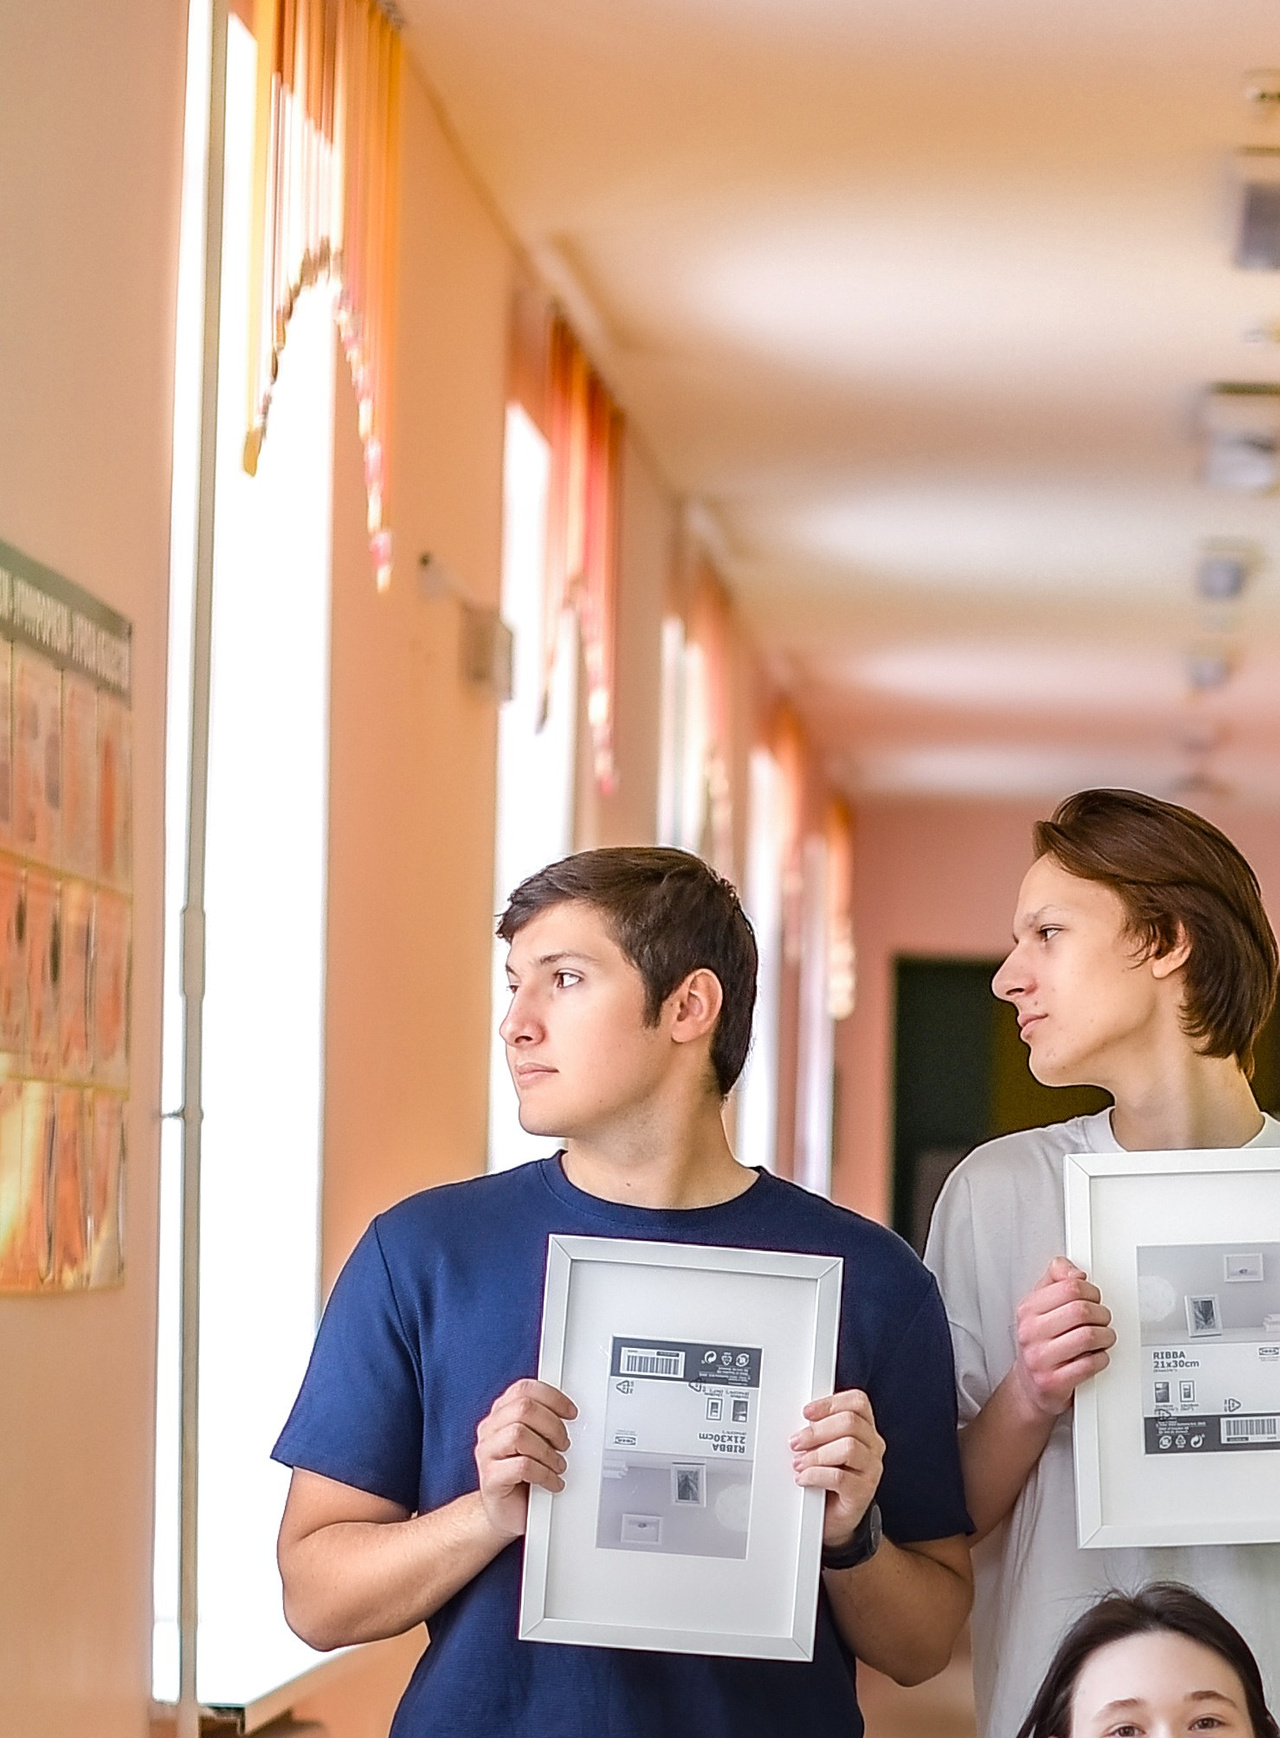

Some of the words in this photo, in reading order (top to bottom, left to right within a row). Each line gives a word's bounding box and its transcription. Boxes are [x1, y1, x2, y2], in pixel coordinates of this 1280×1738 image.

[1153, 1351, 1186, 1360] RIBBA
[1153, 1359, 1200, 1369] 21x30cm
[698, 1432, 746, 1444] 21x30cm
[712, 1443, 746, 1454] RIBBA
